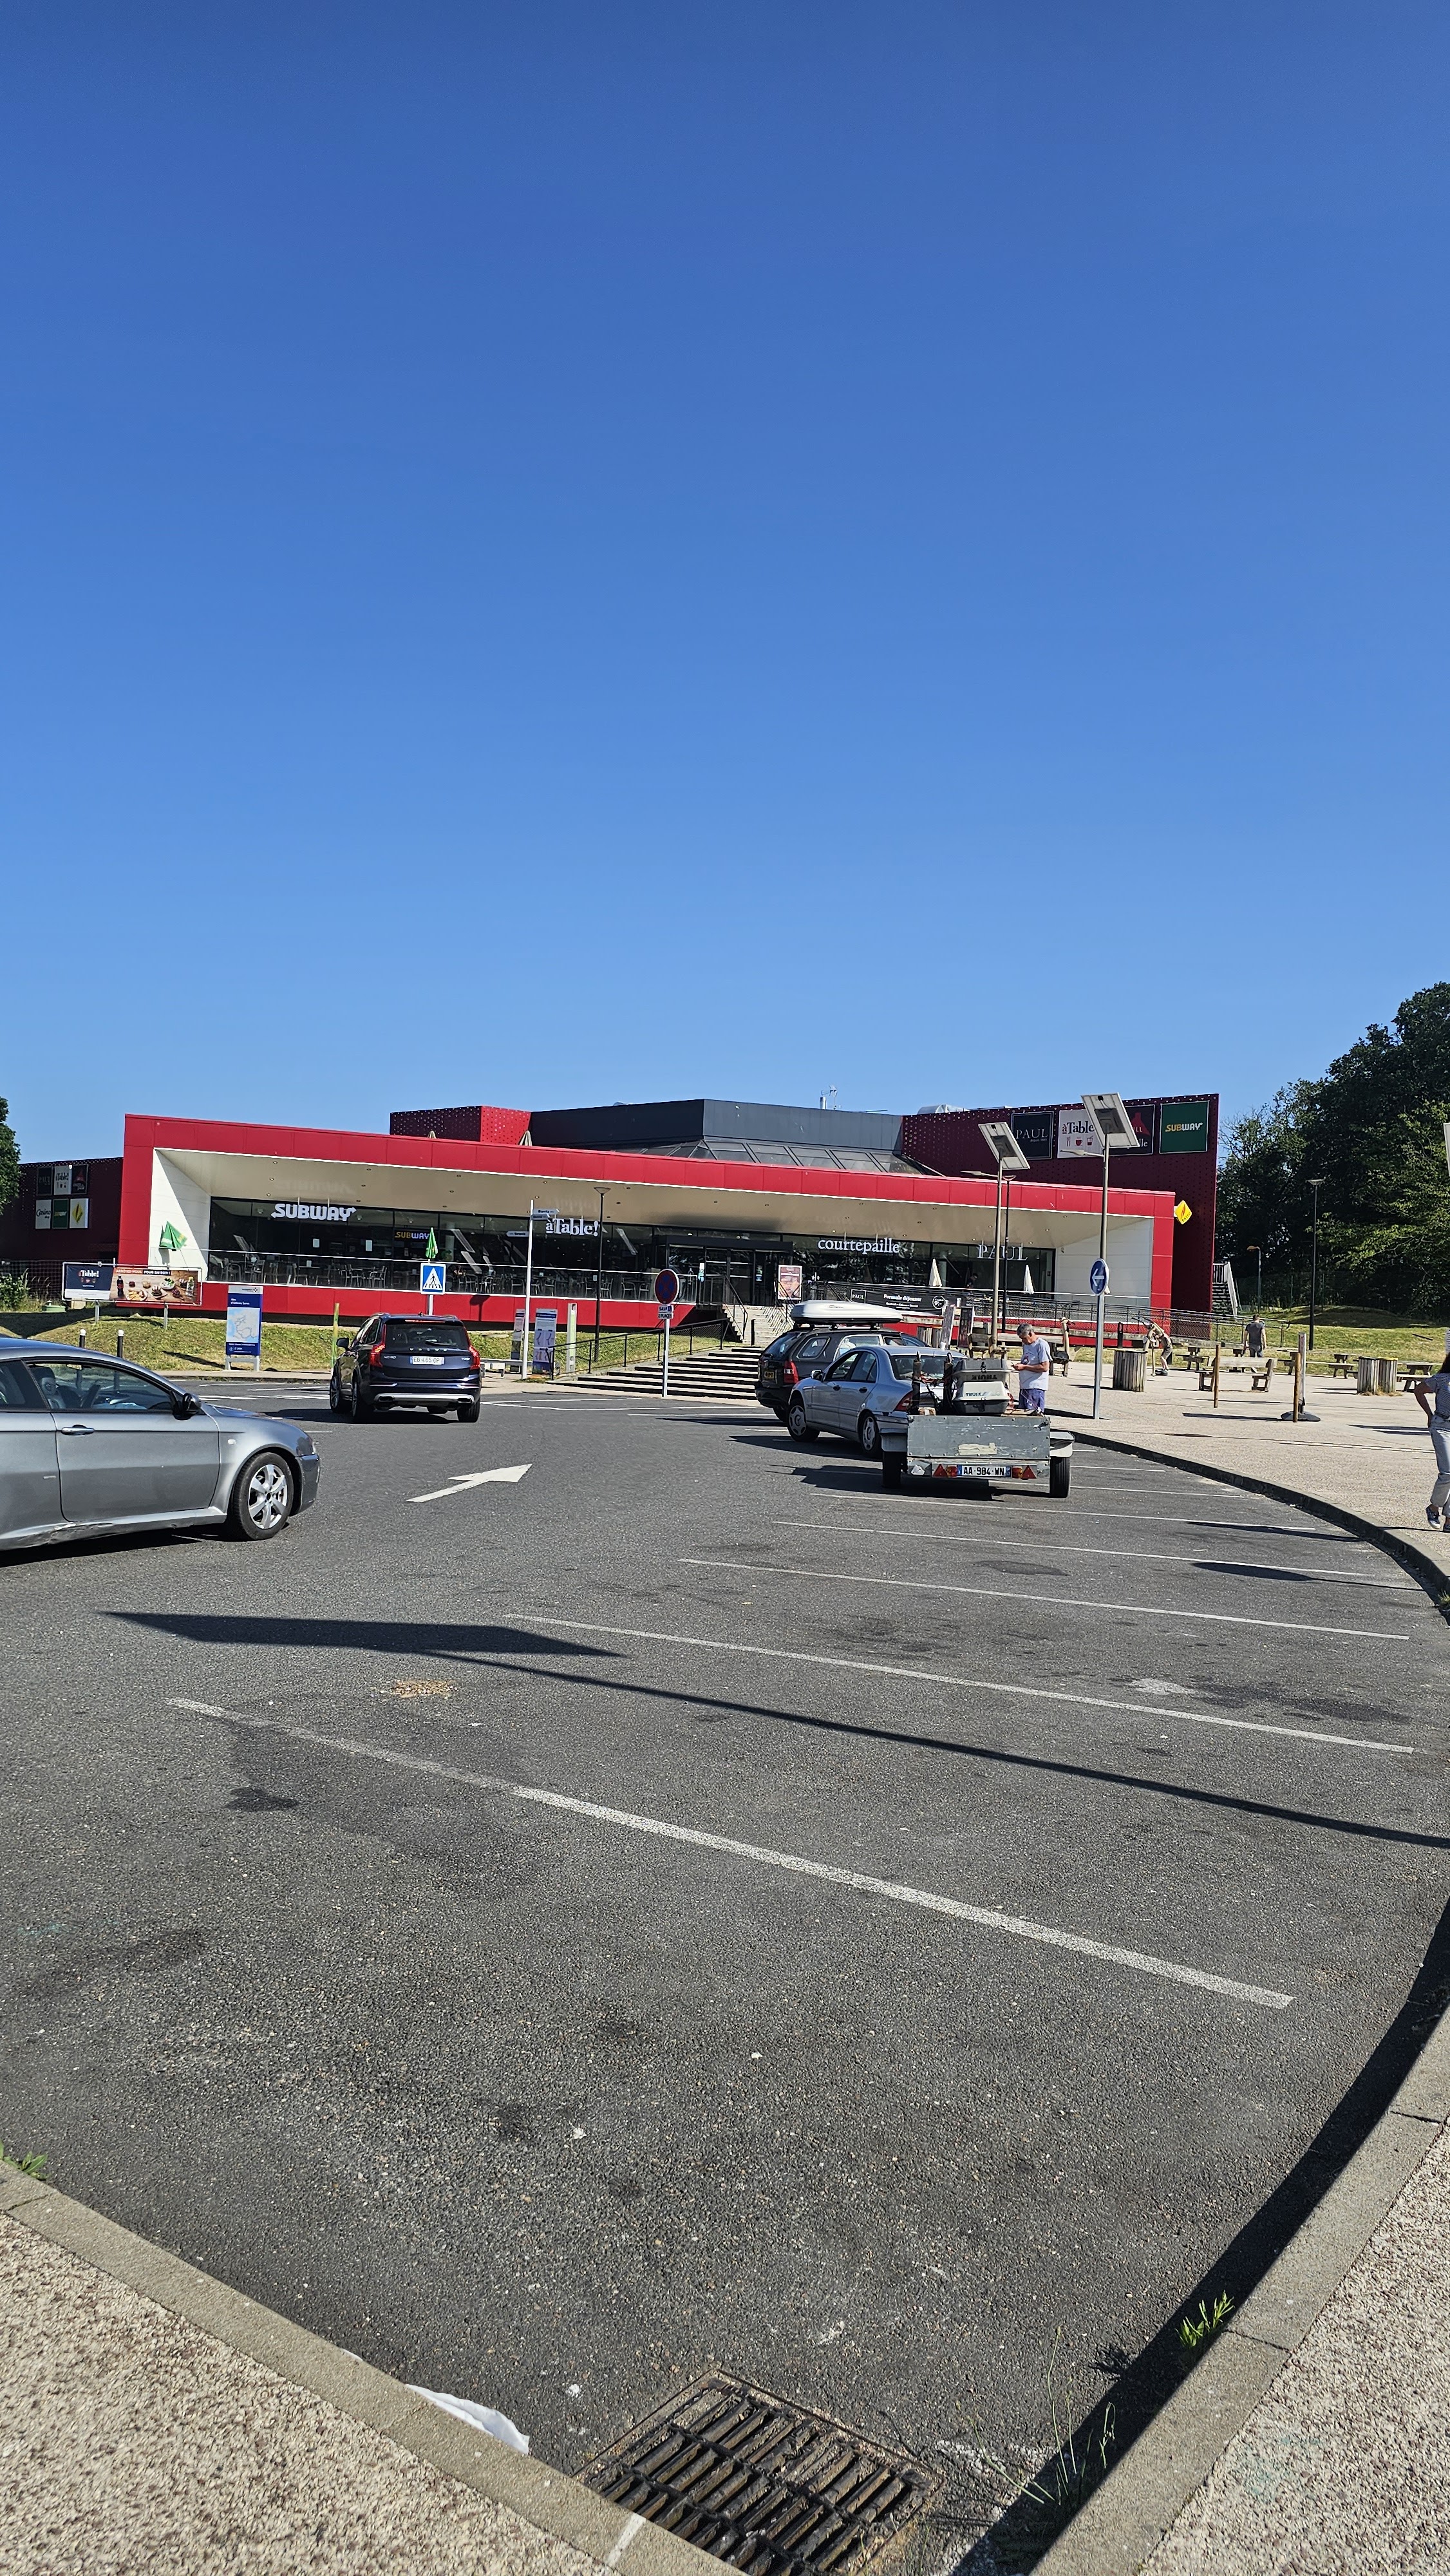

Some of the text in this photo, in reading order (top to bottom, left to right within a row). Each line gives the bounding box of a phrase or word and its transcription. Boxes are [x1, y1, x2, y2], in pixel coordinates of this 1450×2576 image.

[1016, 1128, 1048, 1139] PAUL
[1062, 1121, 1095, 1134] àTable
[1165, 1122, 1203, 1132] SUBWAY
[270, 1203, 357, 1222] SUBWAY
[545, 1218, 599, 1237] àTable!
[395, 1231, 430, 1240] SUBWAY
[818, 1237, 900, 1255] courtepaille
[977, 1244, 1028, 1261] PAUL
